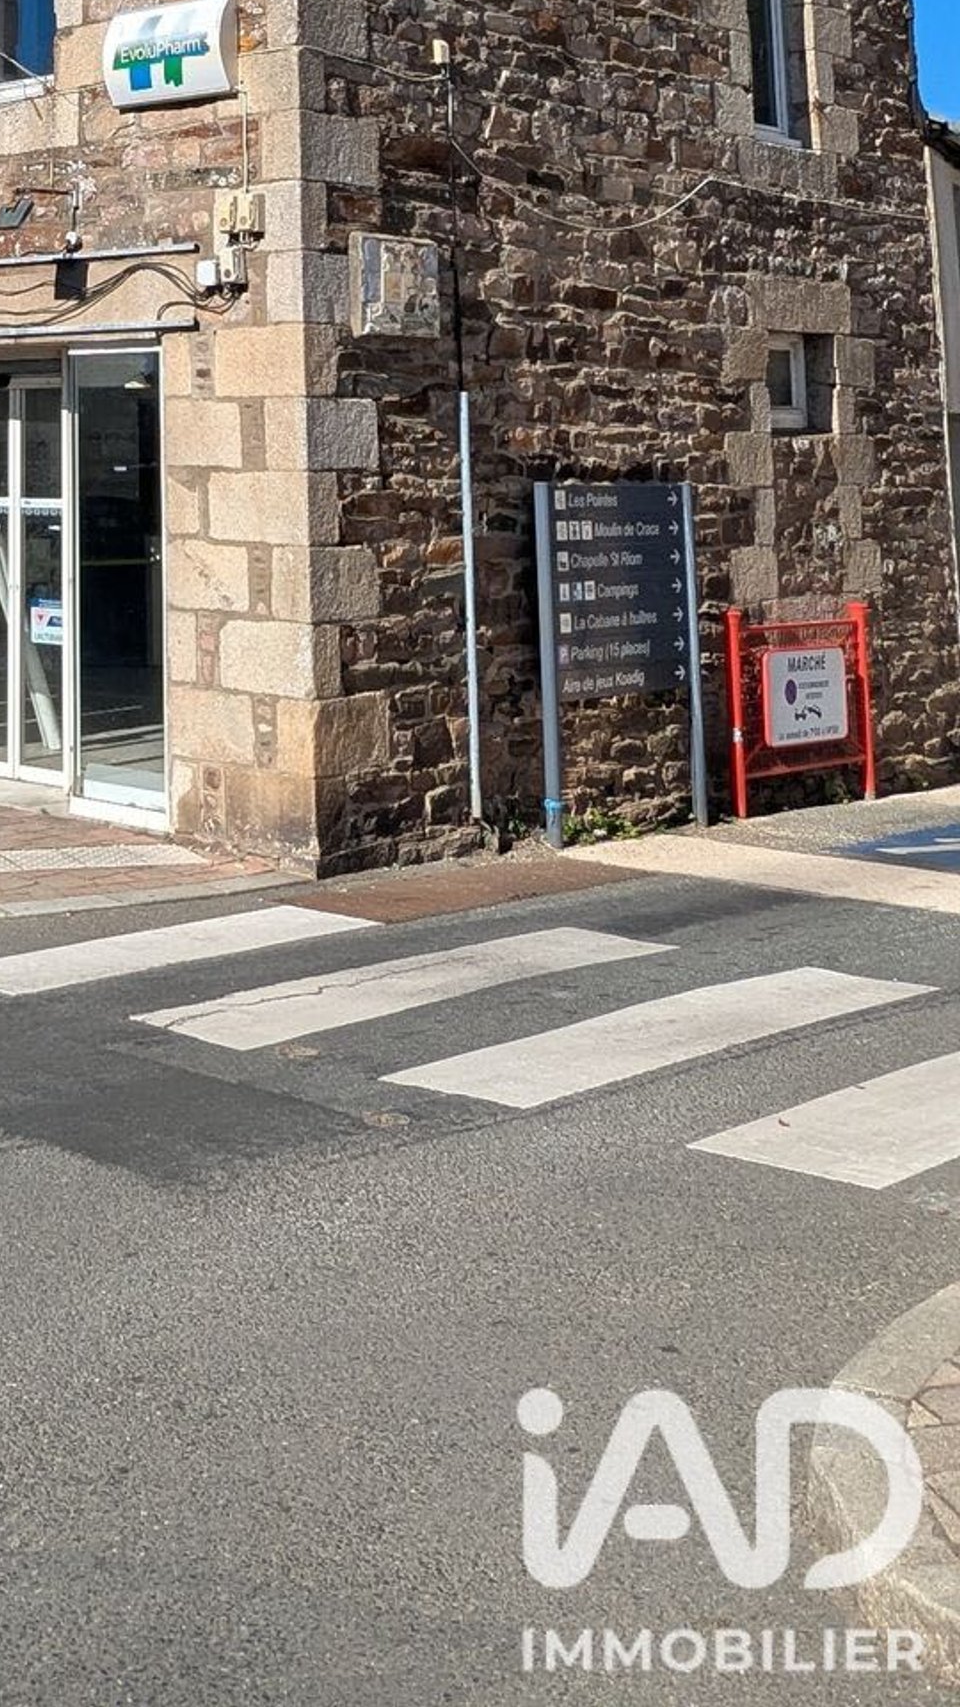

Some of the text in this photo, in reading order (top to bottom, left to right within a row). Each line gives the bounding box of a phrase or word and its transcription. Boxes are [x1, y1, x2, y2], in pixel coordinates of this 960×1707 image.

[121, 39, 202, 63] EvoluPharm
[568, 492, 618, 507] Les Pointes
[594, 521, 622, 537] Moulin
[623, 522, 635, 536] de
[570, 553, 609, 571] Chapelle
[610, 551, 620, 566] St
[597, 582, 639, 600] Campings
[574, 615, 586, 631] La
[587, 614, 620, 630] Cabane
[570, 645, 604, 662] Parking
[620, 639, 651, 660] places)
[787, 651, 826, 672] MARCHÉ
[562, 677, 581, 694] Aire
[582, 676, 595, 692] de
[595, 674, 614, 693] jeux
